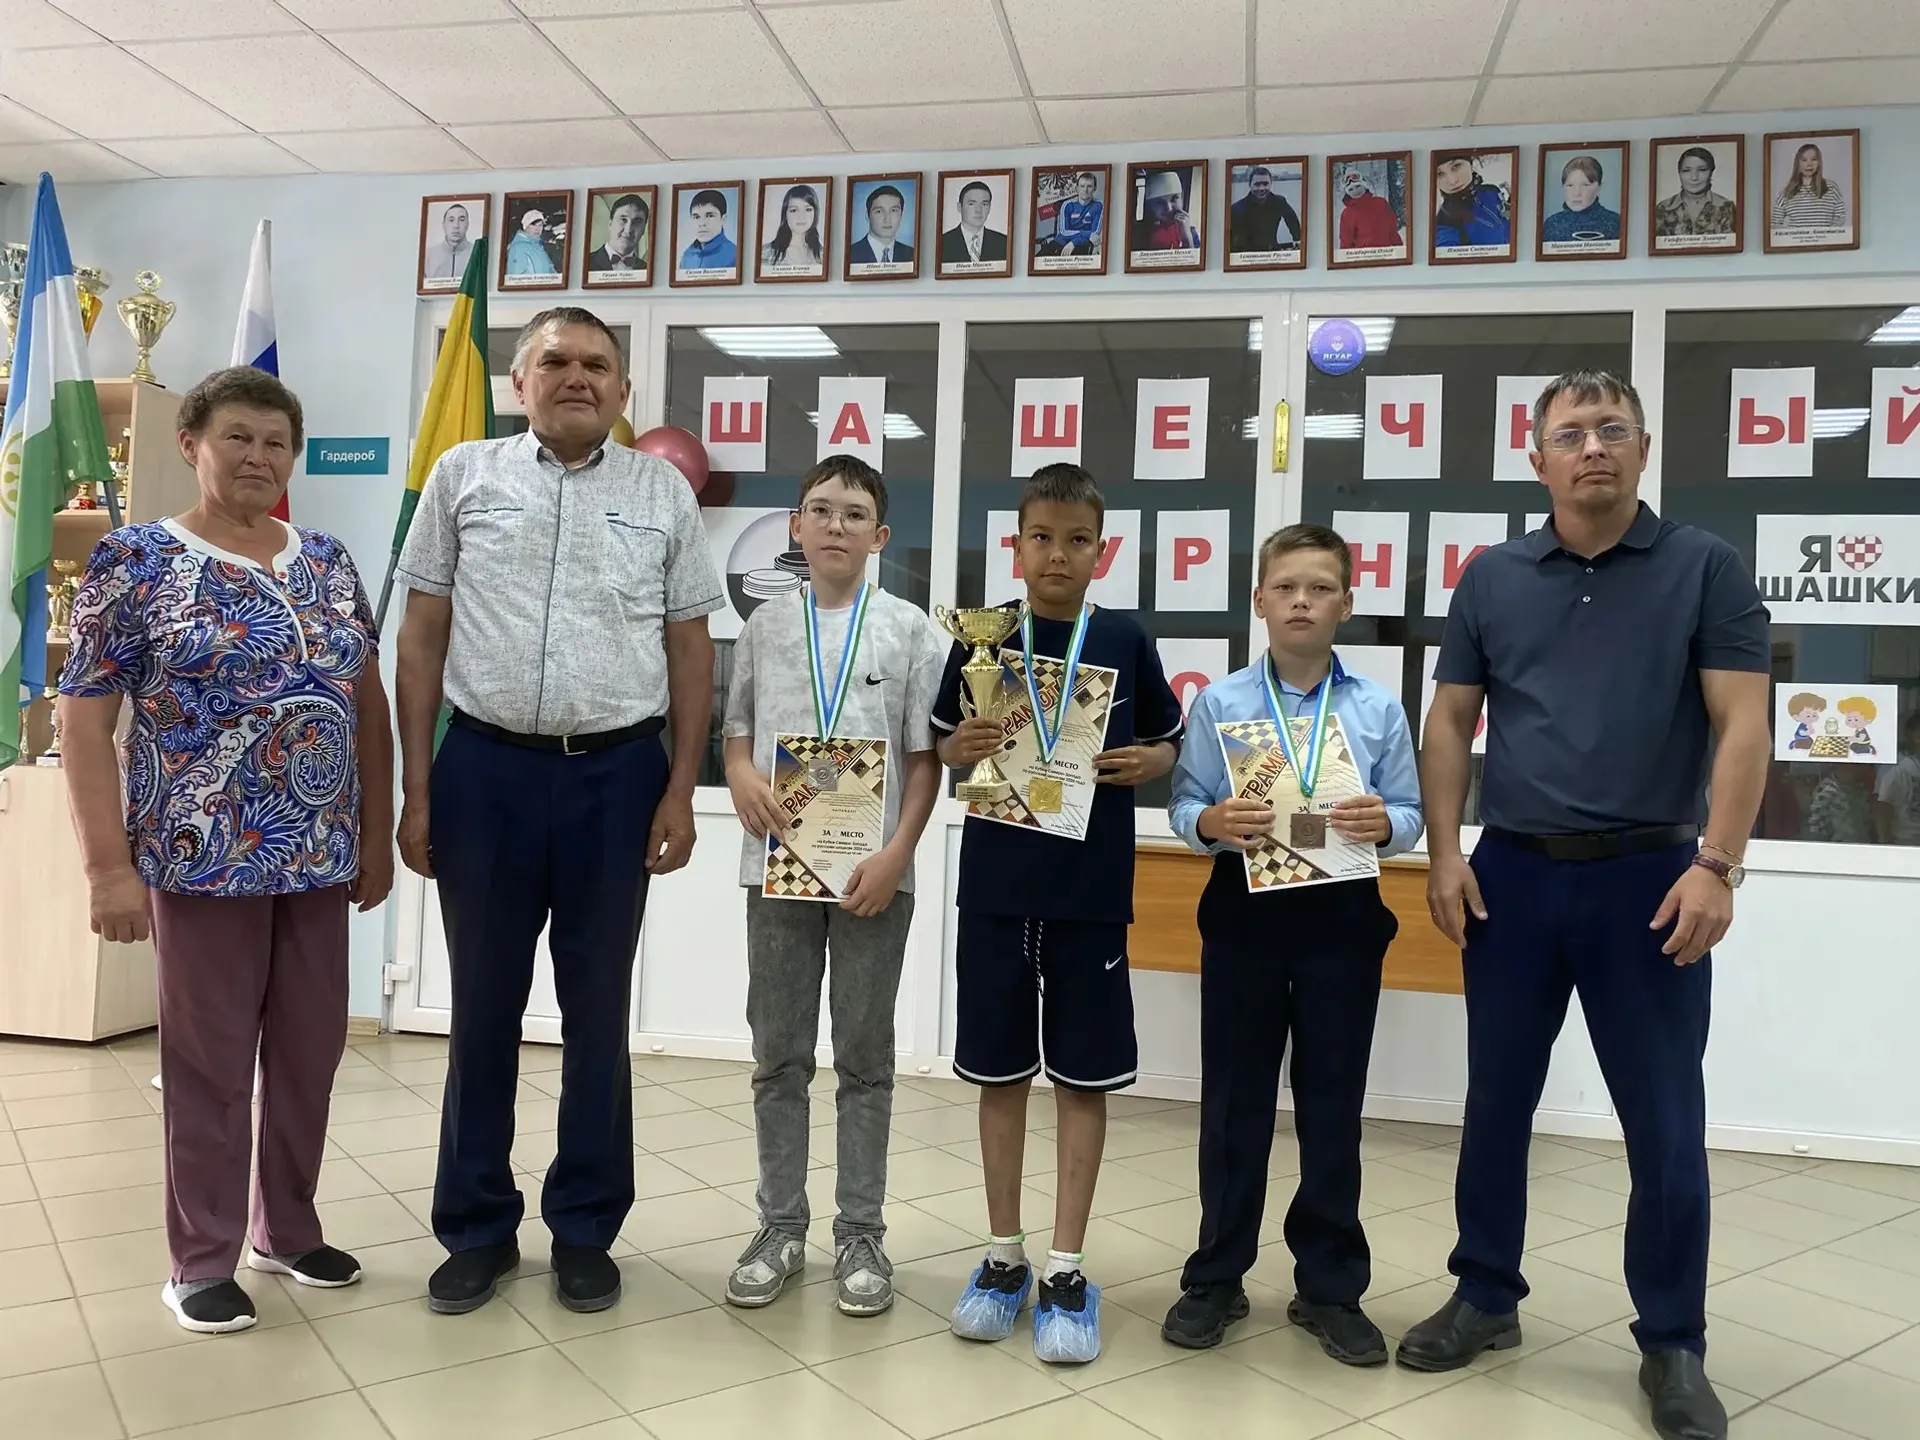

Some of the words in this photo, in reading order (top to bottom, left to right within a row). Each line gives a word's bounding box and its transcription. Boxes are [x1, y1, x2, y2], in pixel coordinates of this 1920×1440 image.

[320, 450, 376, 463] Гардероб
[1798, 534, 1832, 573] Я
[1759, 576, 1920, 603] ШАШКИ
[1054, 760, 1079, 770] МЕСТО
